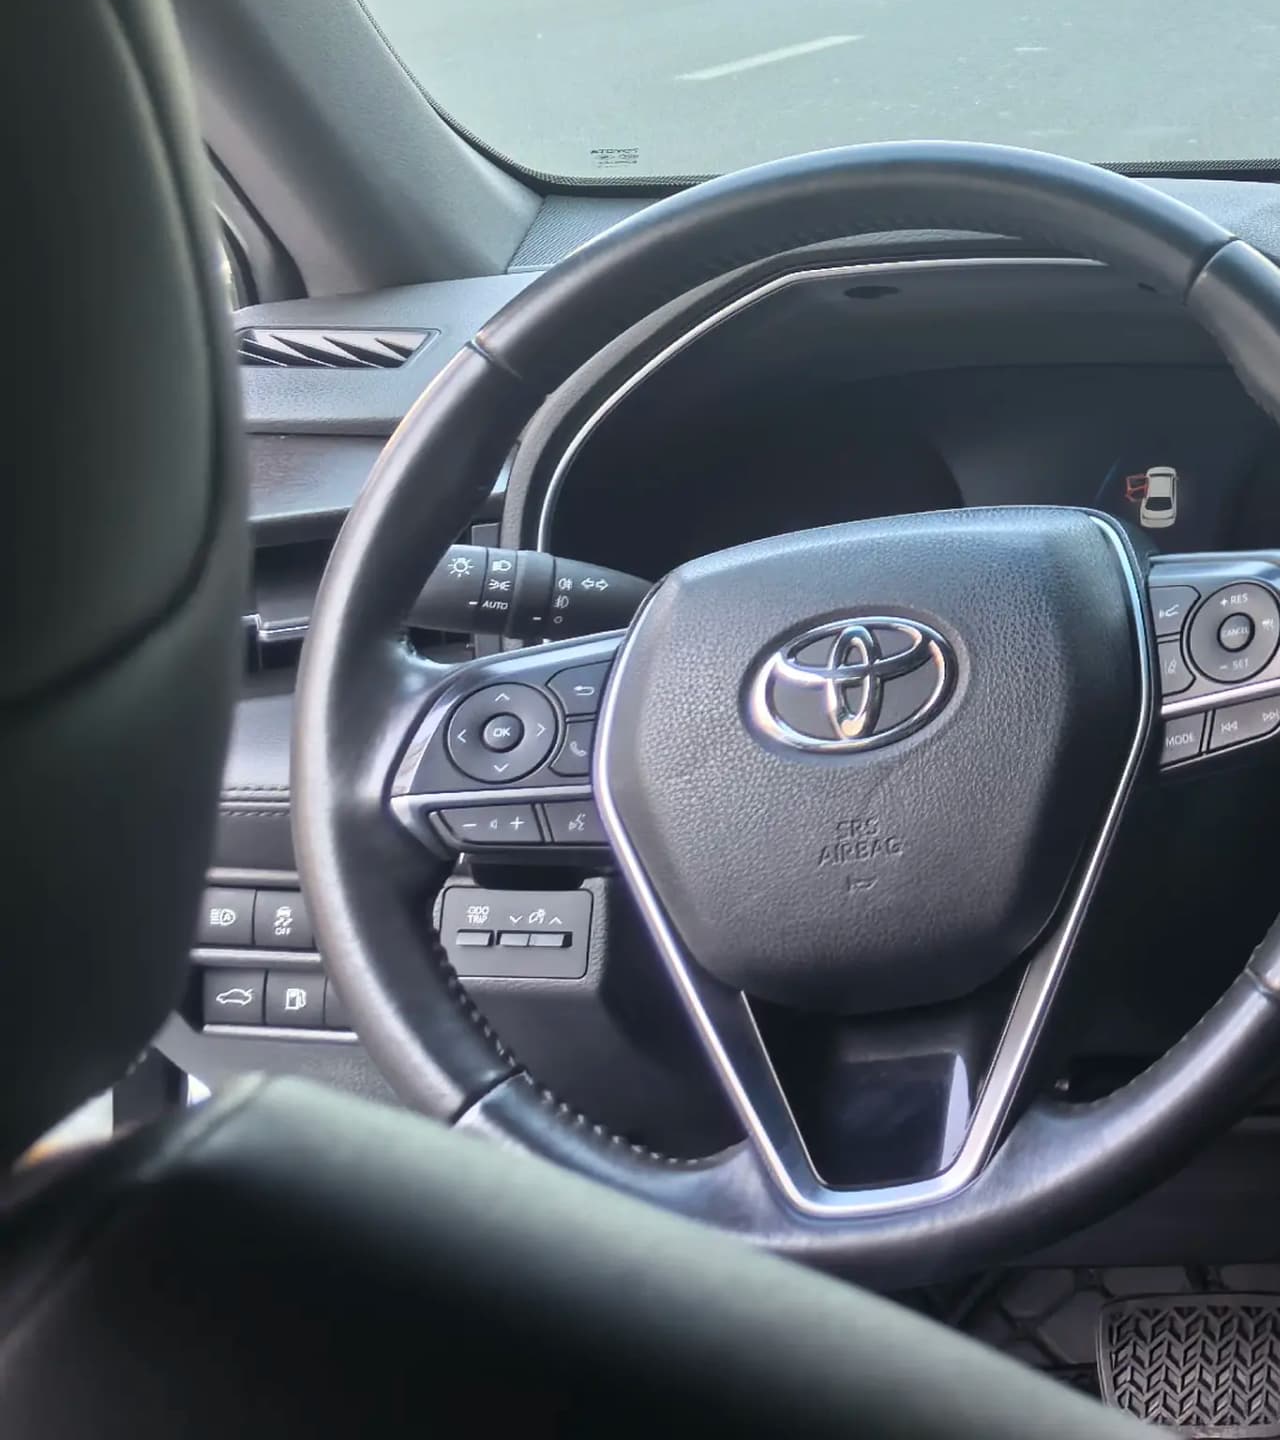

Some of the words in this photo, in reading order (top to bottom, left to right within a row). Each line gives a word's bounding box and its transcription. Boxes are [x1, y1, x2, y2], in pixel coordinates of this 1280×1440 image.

[1230, 593, 1249, 604] RES
[482, 600, 509, 610] AUTO
[1233, 658, 1249, 670] SET
[493, 727, 511, 738] OK
[1166, 732, 1194, 748] MODE
[818, 836, 904, 866] AIRBAG
